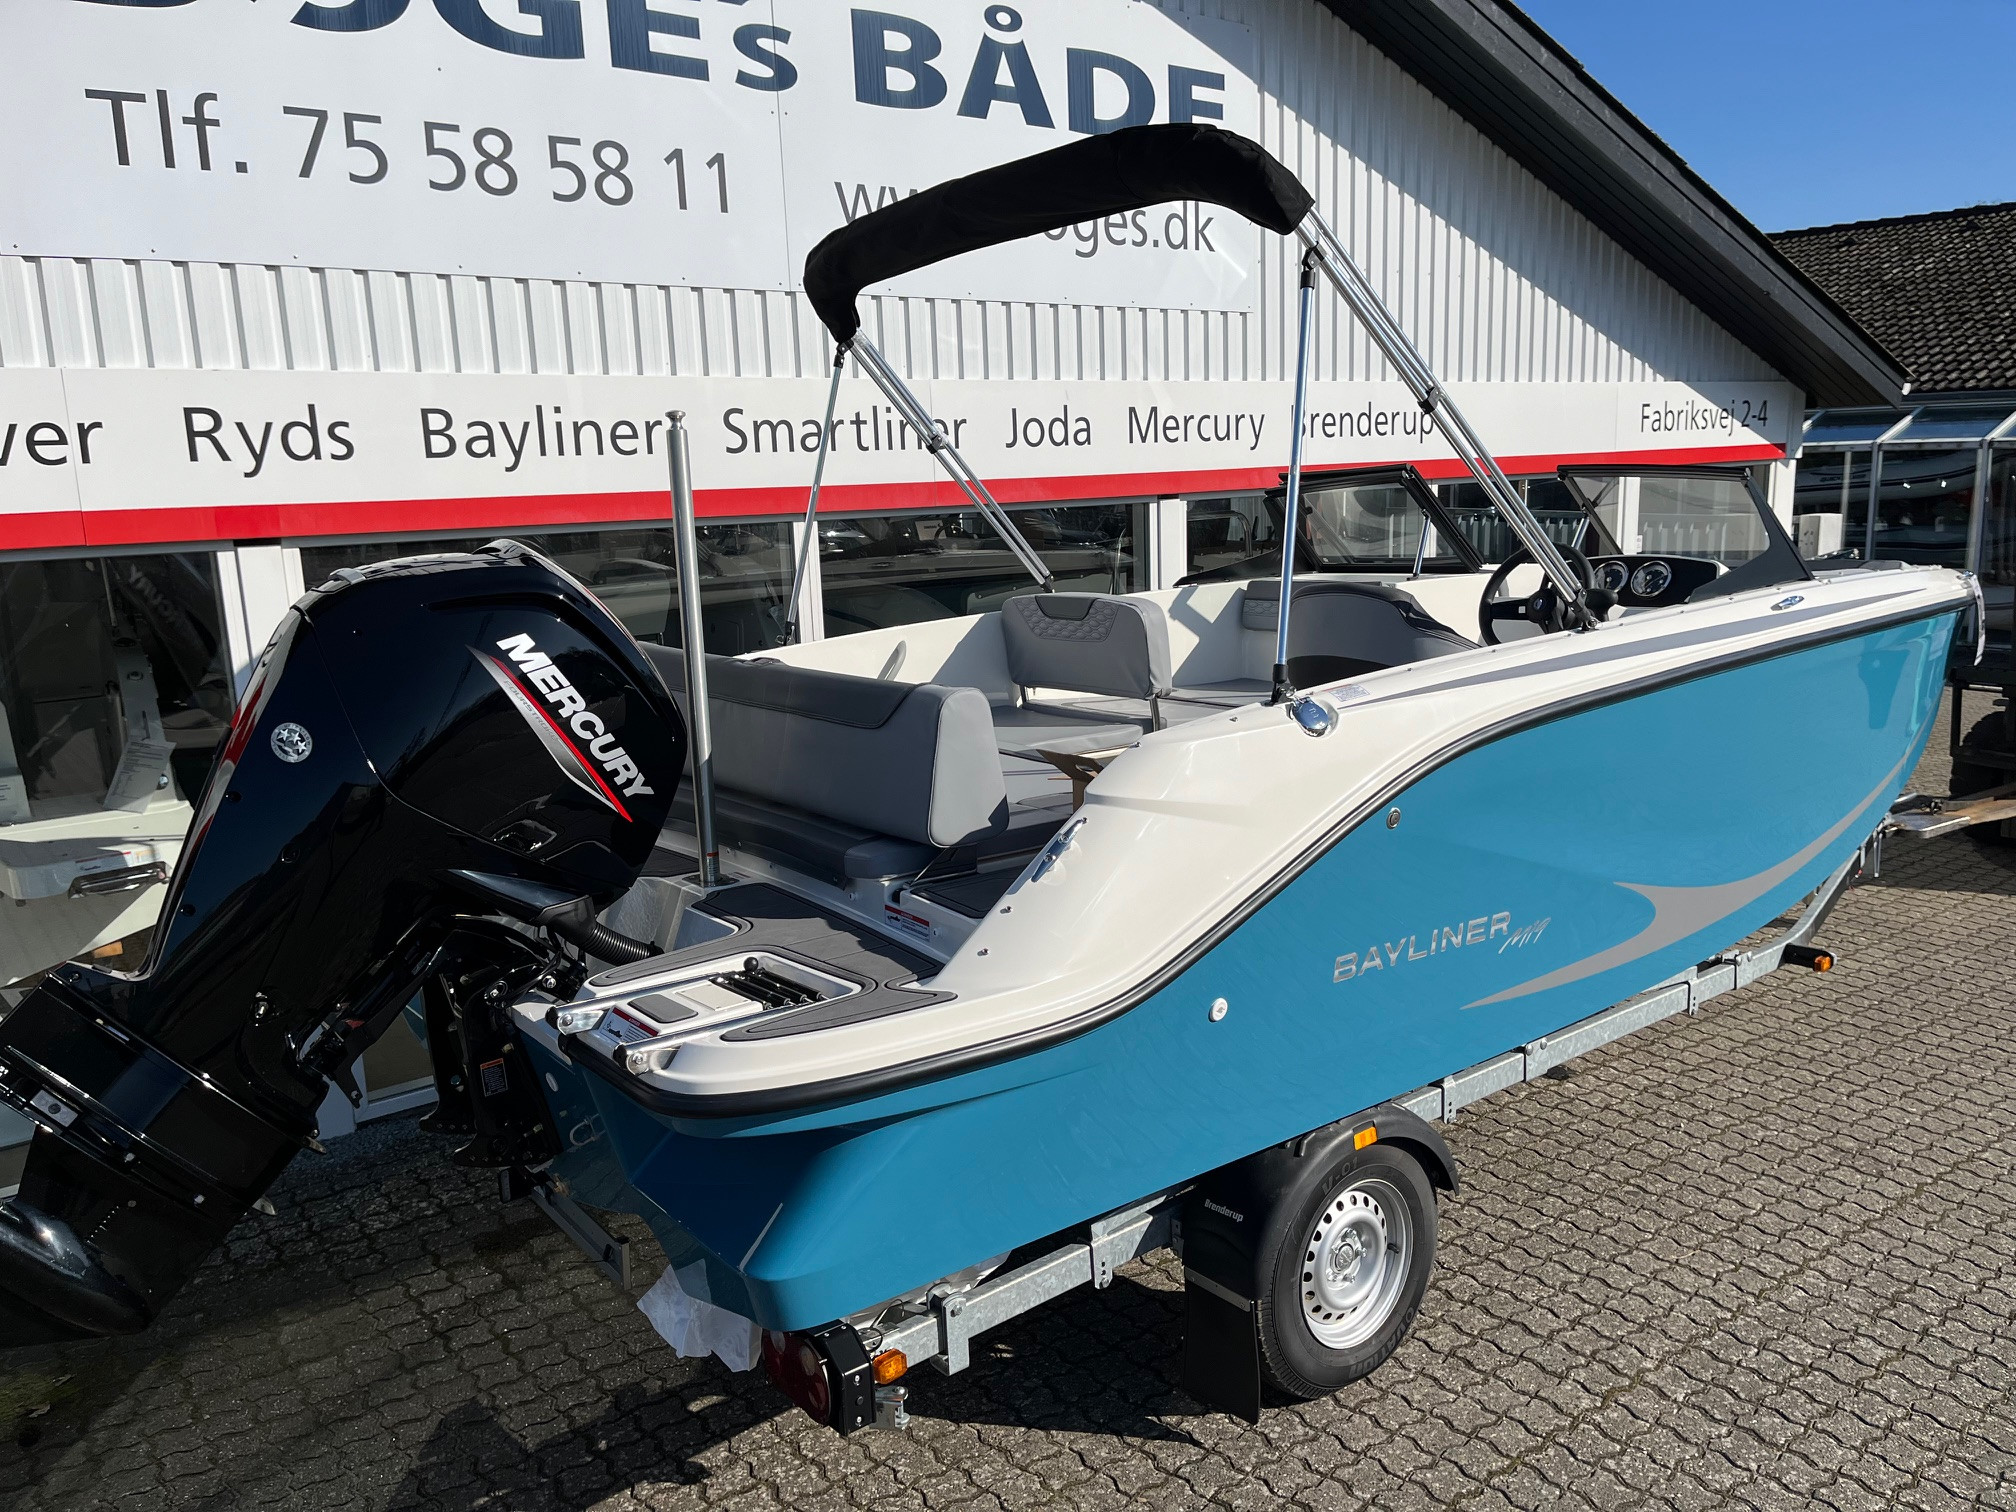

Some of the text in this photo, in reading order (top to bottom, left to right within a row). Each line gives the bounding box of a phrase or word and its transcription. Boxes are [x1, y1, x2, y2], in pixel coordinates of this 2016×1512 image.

[850, 4, 1226, 136] BÅDE
[84, 88, 729, 213] Tlf. 75 58 58 11
[182, 403, 355, 478] Ryds
[420, 404, 662, 473] Bayliner
[1005, 404, 1092, 449] Joda
[1128, 405, 1265, 451] Mercury
[1641, 399, 1768, 437] Fabriksvej 2-4
[496, 633, 655, 798] MERCURY
[1333, 911, 1511, 984] BAYLINER
[1203, 1198, 1244, 1223] Brenderup
